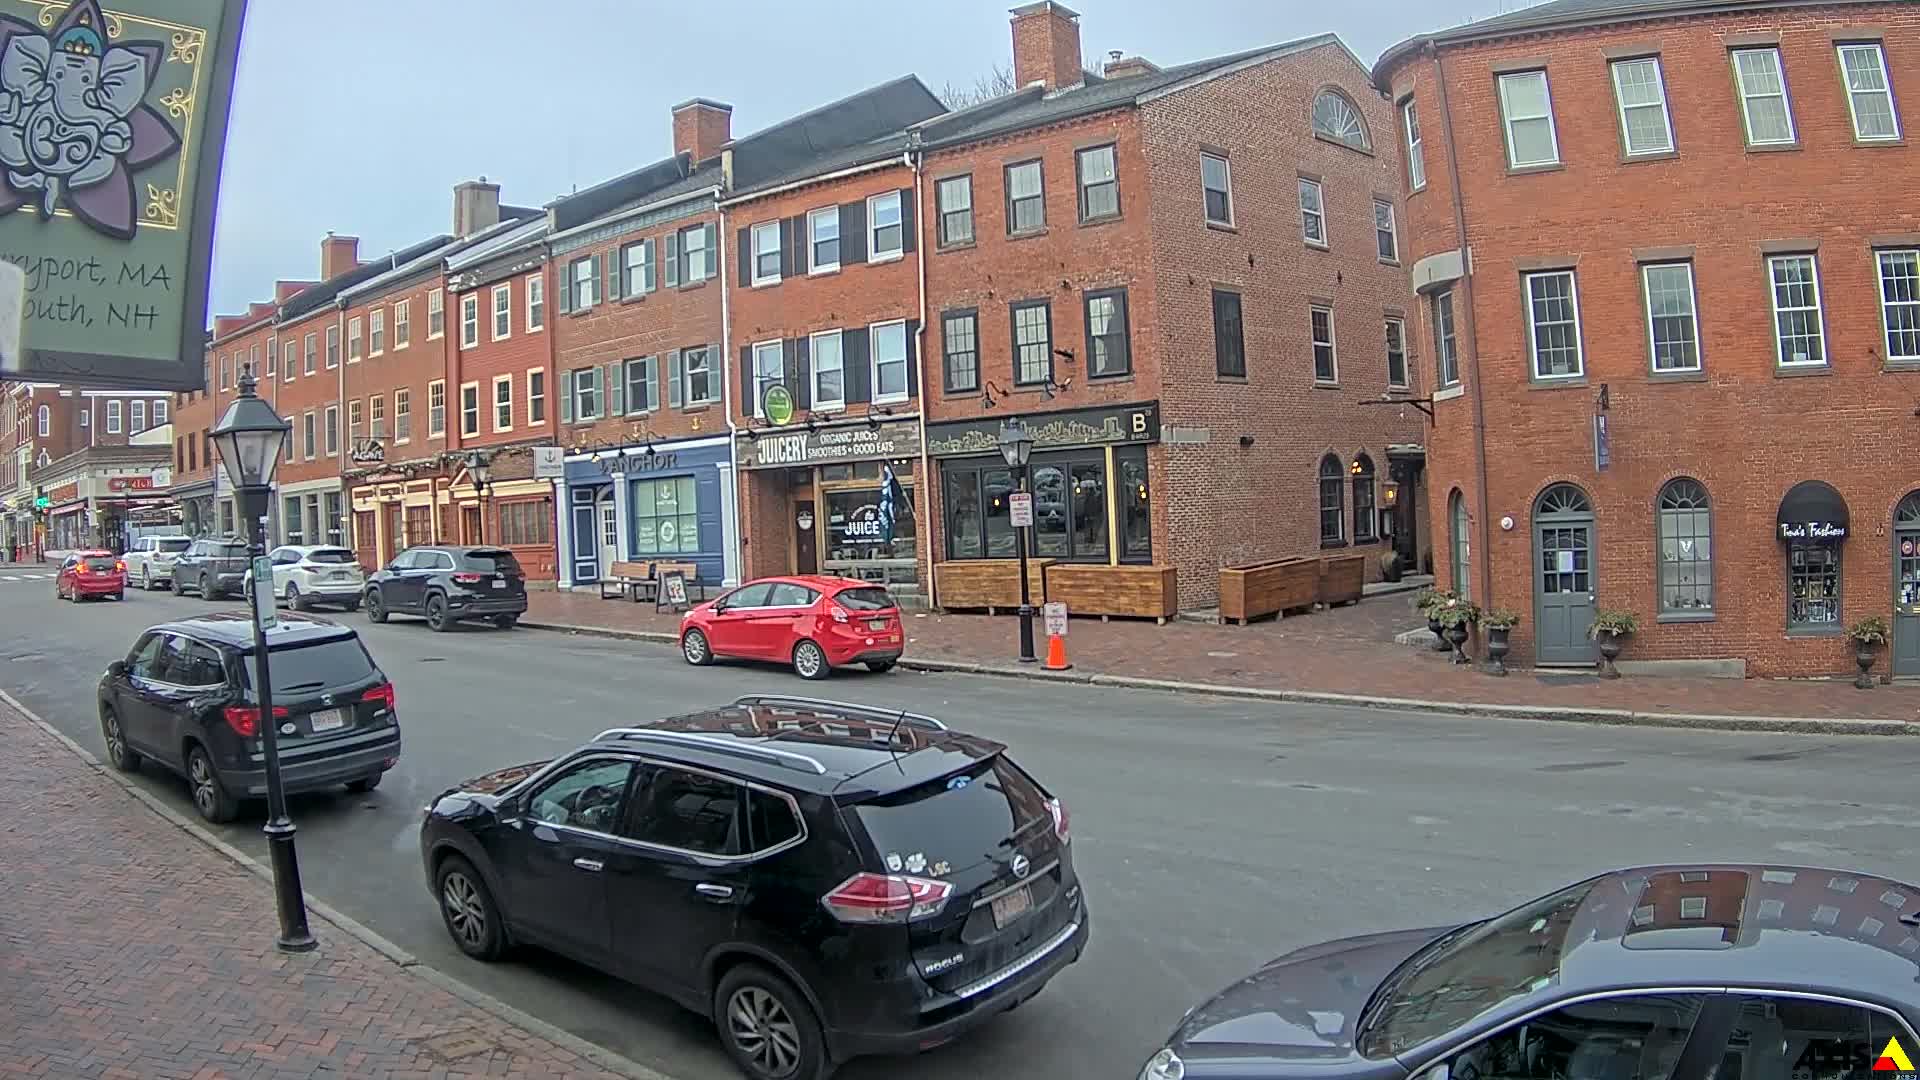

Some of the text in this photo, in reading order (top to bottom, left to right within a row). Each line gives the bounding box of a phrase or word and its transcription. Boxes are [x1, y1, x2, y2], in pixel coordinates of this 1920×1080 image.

[0, 254, 171, 292] ryport, MA
[107, 302, 159, 331] NH
[1132, 413, 1146, 433] B
[820, 431, 852, 445] ORGANIC
[853, 443, 876, 455] GOOD
[877, 441, 895, 454] EATS
[758, 434, 808, 464] JUICERY
[609, 453, 679, 474] ANCHOR
[844, 520, 880, 536] JUICE
